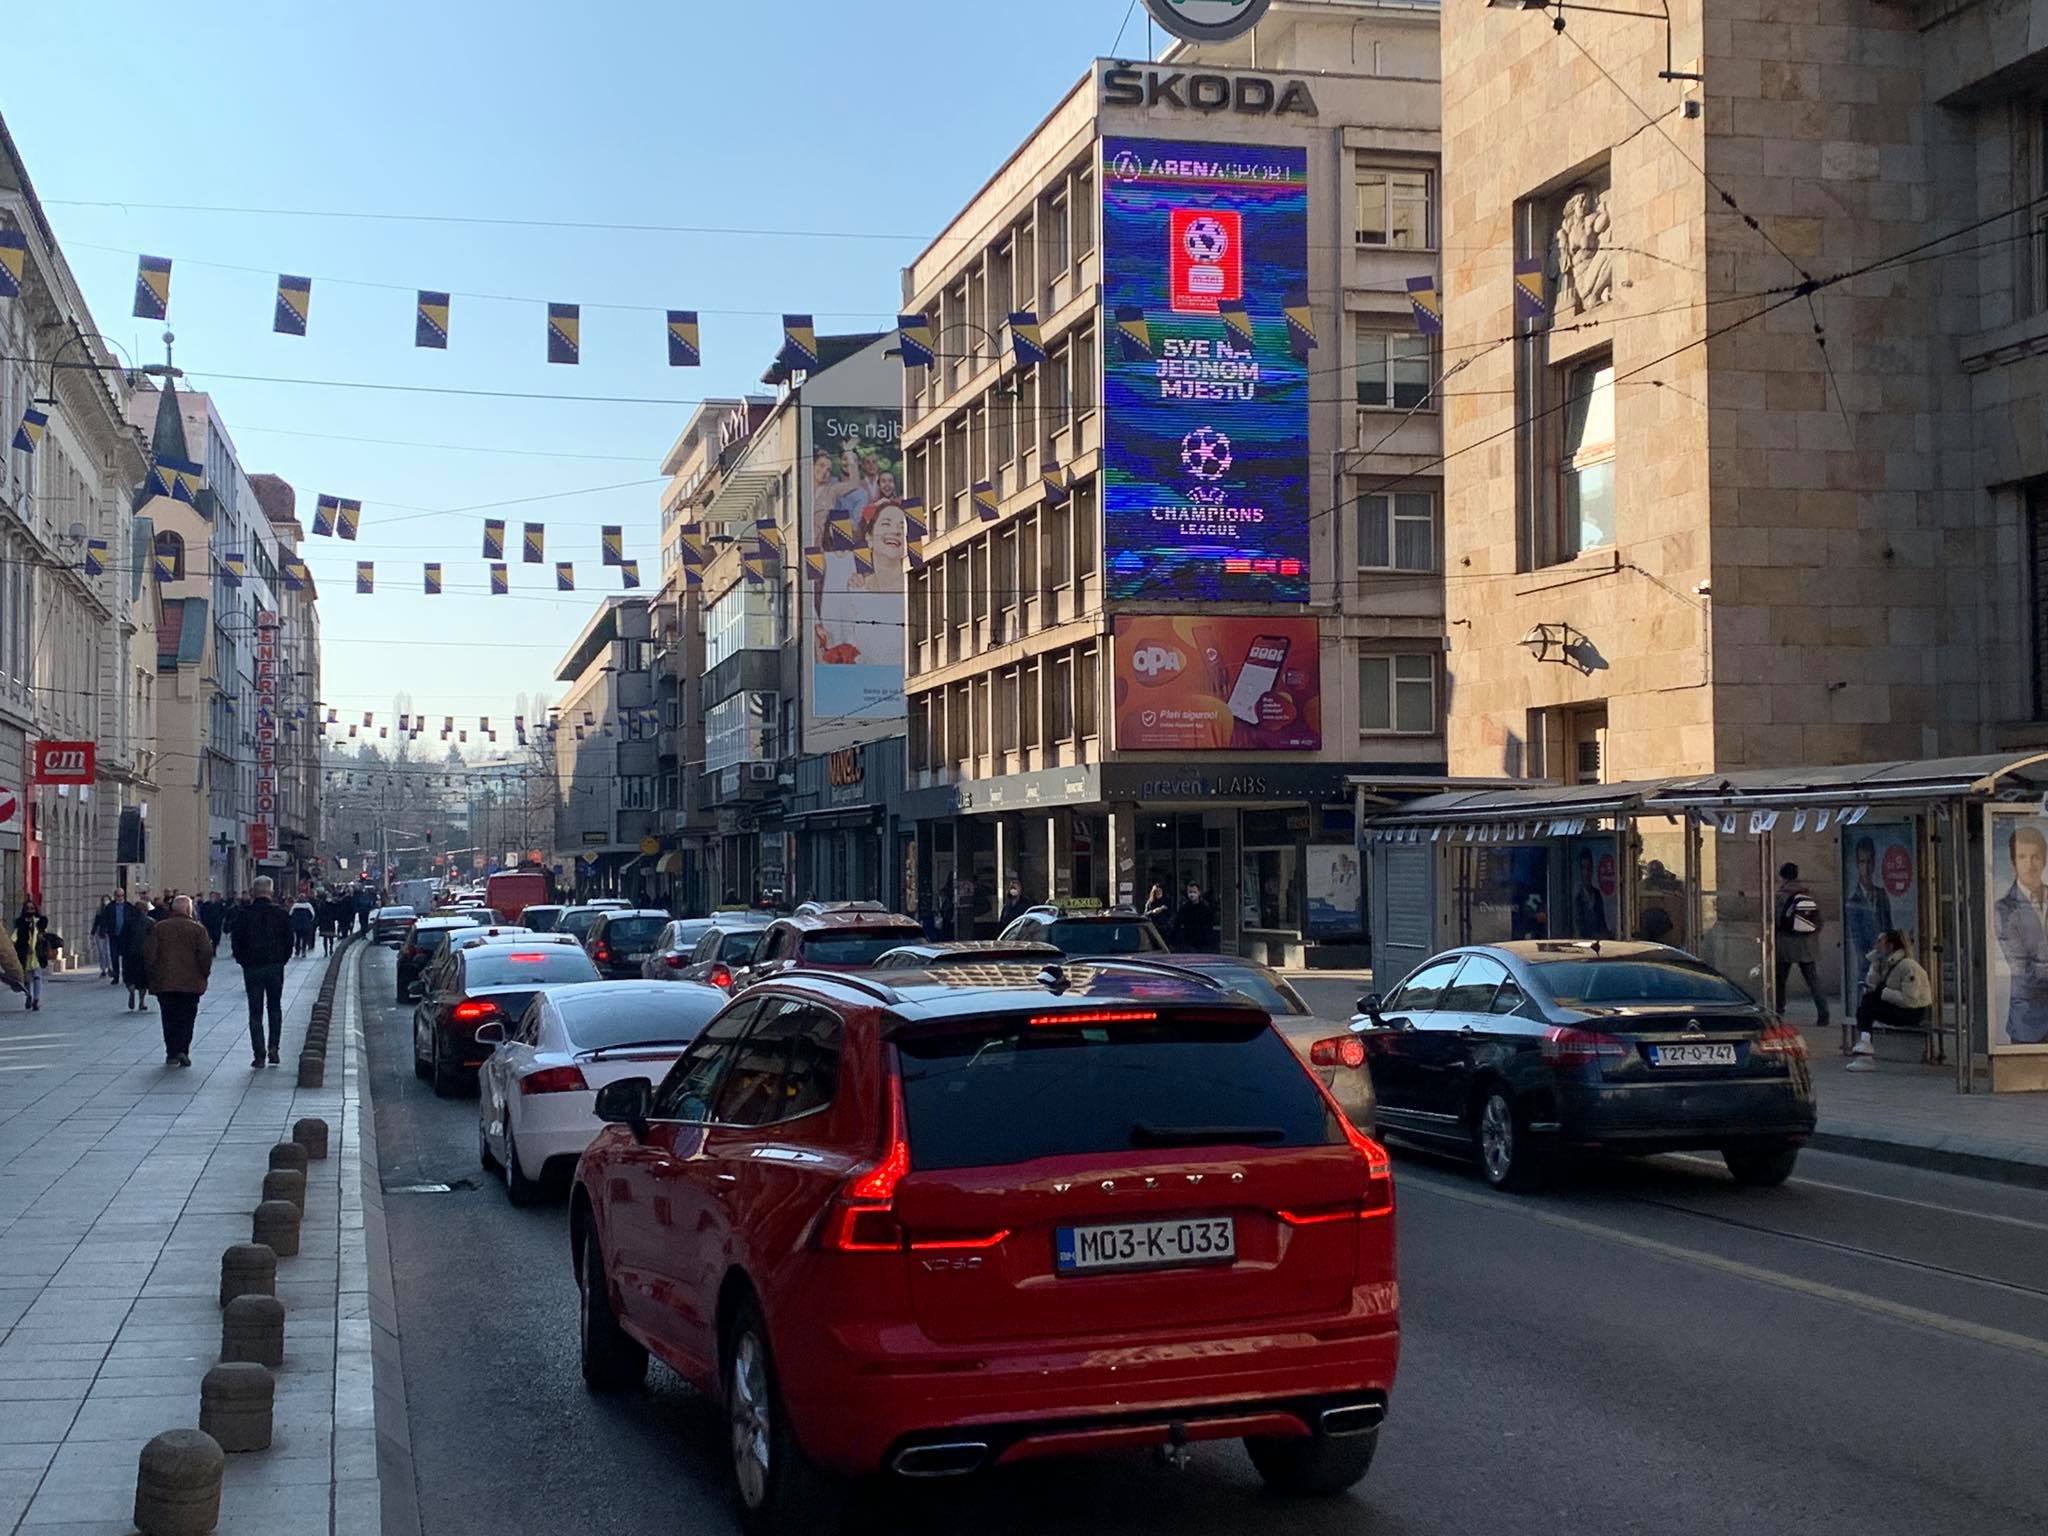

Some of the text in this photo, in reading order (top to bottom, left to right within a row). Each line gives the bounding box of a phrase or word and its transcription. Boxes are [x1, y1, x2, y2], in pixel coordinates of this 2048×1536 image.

[1104, 59, 1319, 118] ŠKODA
[1163, 339, 1210, 357] SVE
[1155, 359, 1259, 380] JEDNOM
[1161, 380, 1255, 400] MJESTU
[826, 418, 860, 438] Sve
[1151, 506, 1265, 523] CHAMPIONS
[1180, 523, 1237, 536] LEAGUE
[44, 751, 85, 769] cm
[1053, 1172, 1245, 1194] VOLVO
[1079, 1221, 1232, 1262] M03-K-033
